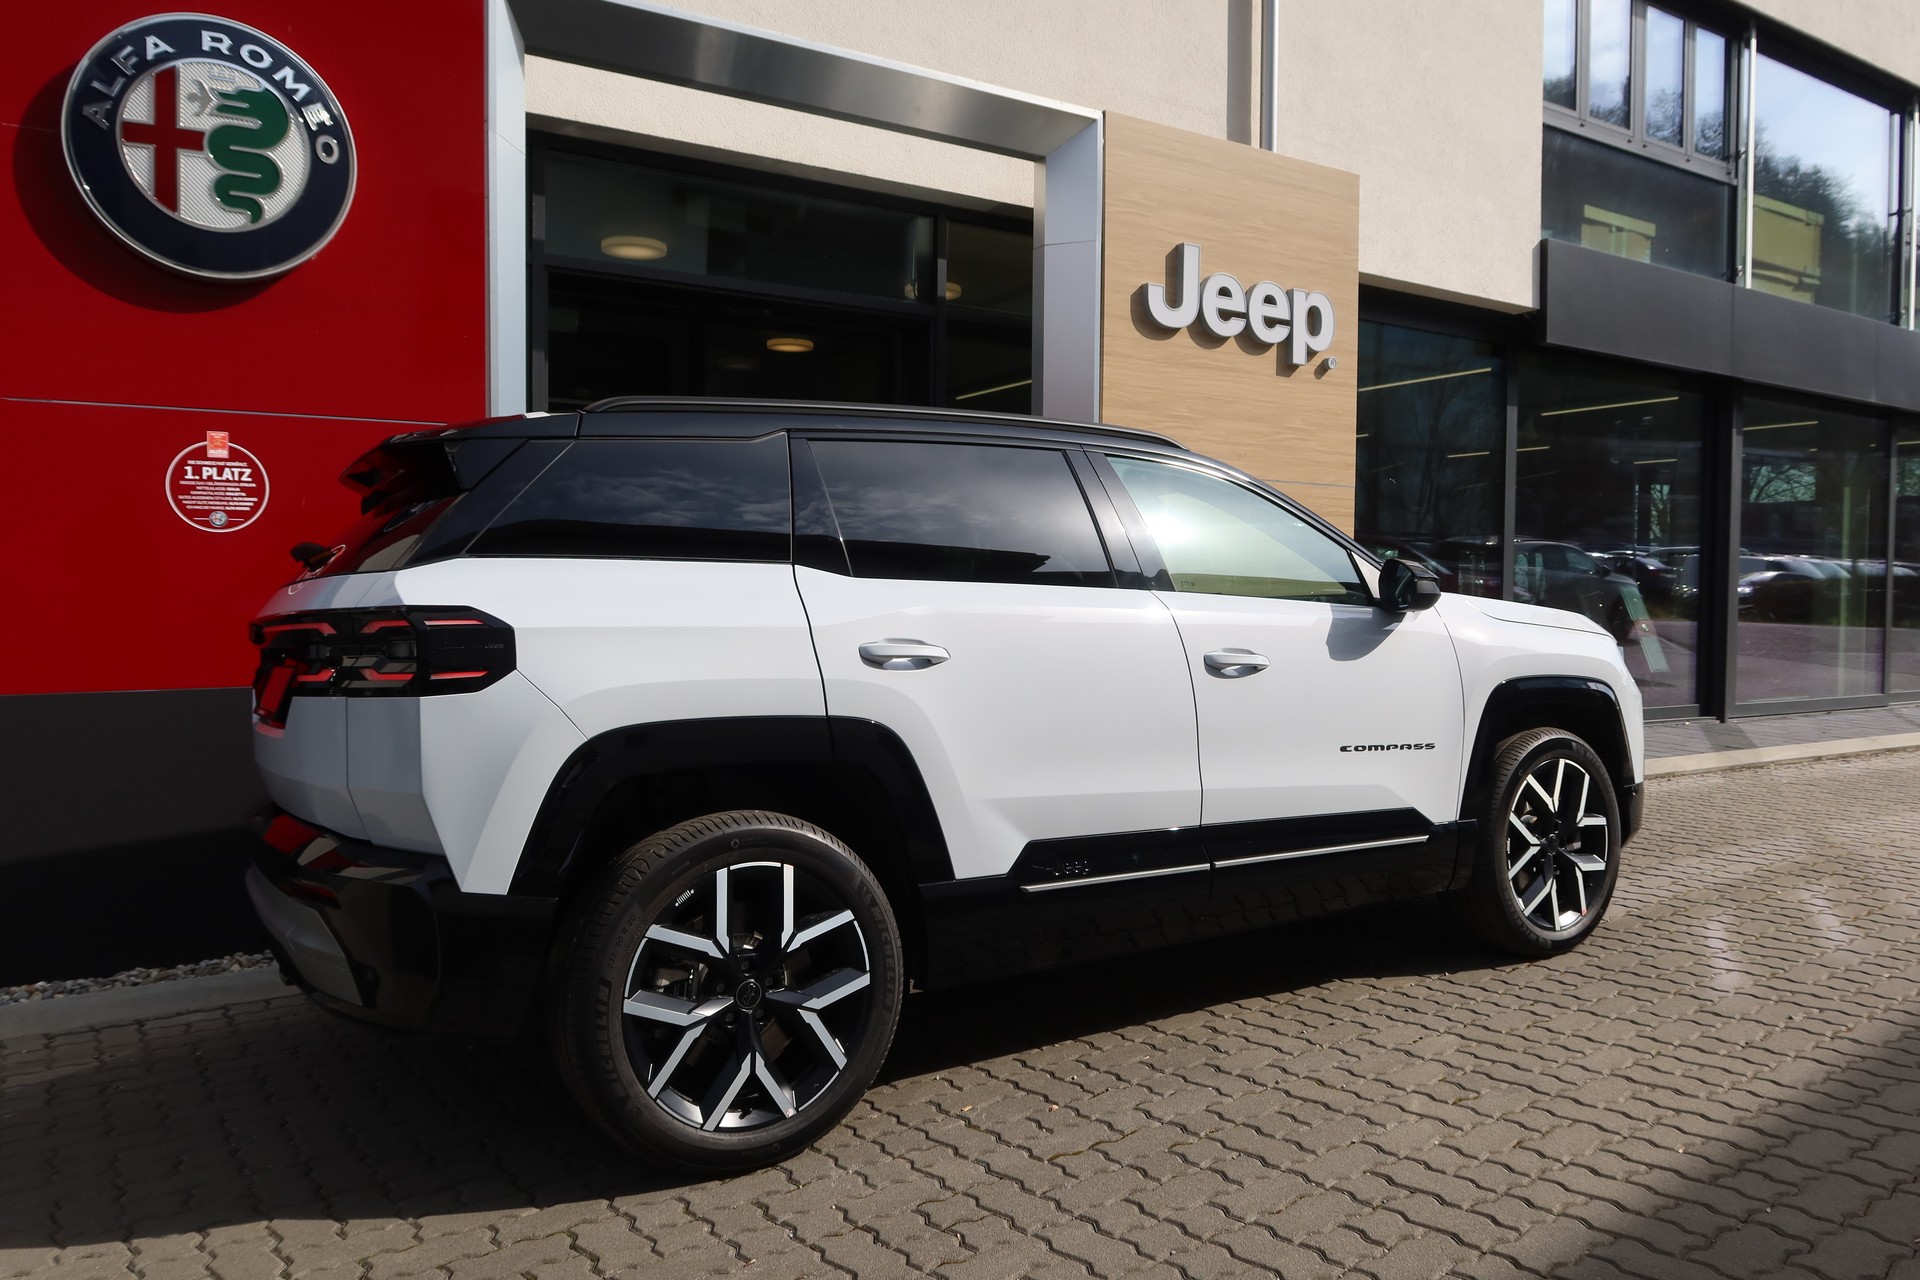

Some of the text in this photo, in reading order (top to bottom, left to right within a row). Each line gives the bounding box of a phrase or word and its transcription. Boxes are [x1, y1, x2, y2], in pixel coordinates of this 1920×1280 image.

[82, 30, 340, 165] ALFA ROMEO
[1147, 242, 1336, 367] Jeep
[184, 466, 253, 481] 1. PLATZ
[1340, 743, 1436, 752] COMPASS
